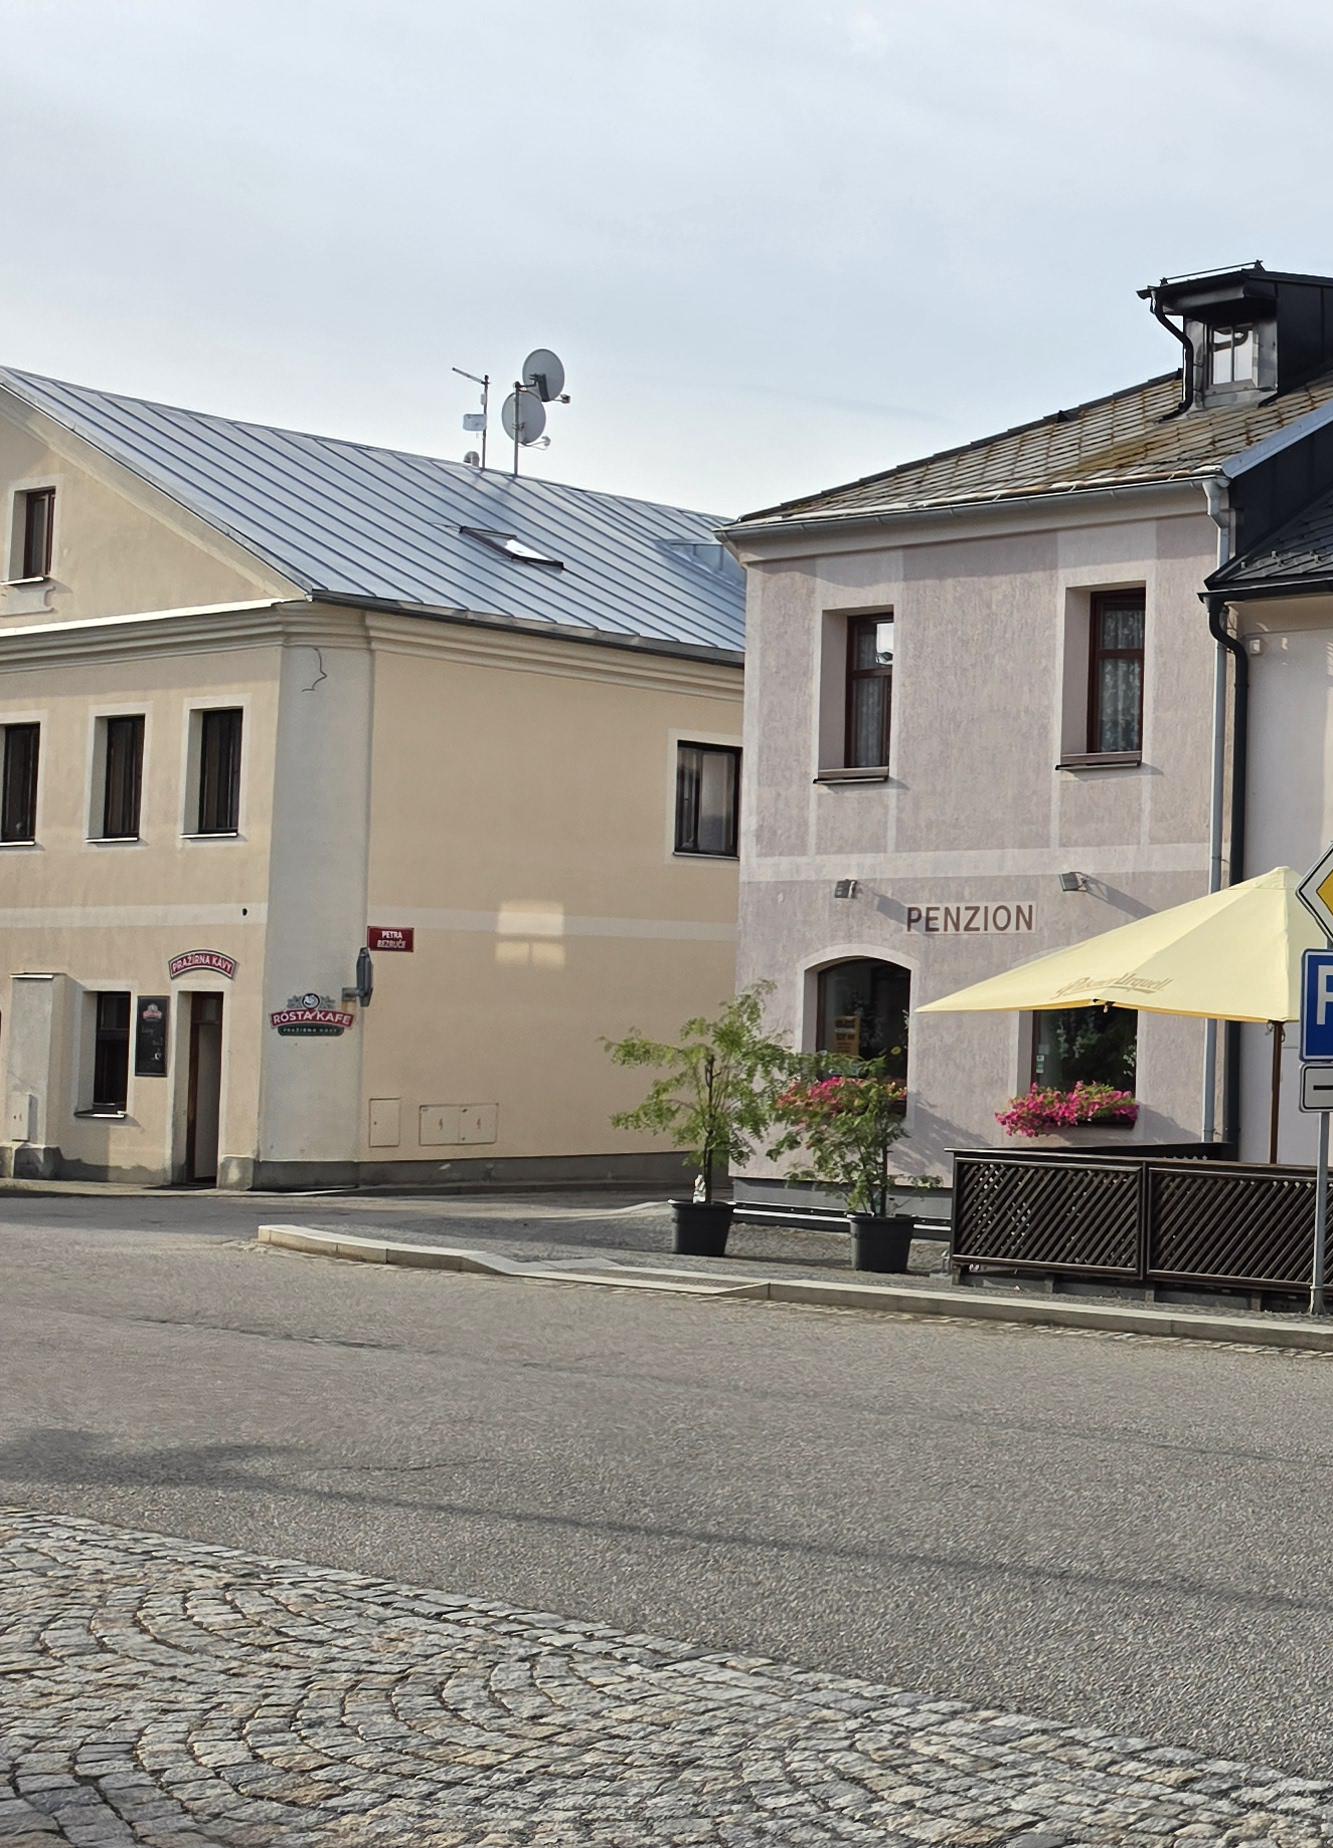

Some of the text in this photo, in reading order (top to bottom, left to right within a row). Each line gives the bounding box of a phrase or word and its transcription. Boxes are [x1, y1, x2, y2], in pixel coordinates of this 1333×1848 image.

[907, 905, 1033, 932] PENZION
[381, 930, 403, 939] PETRA
[316, 1010, 352, 1025] KAFE
